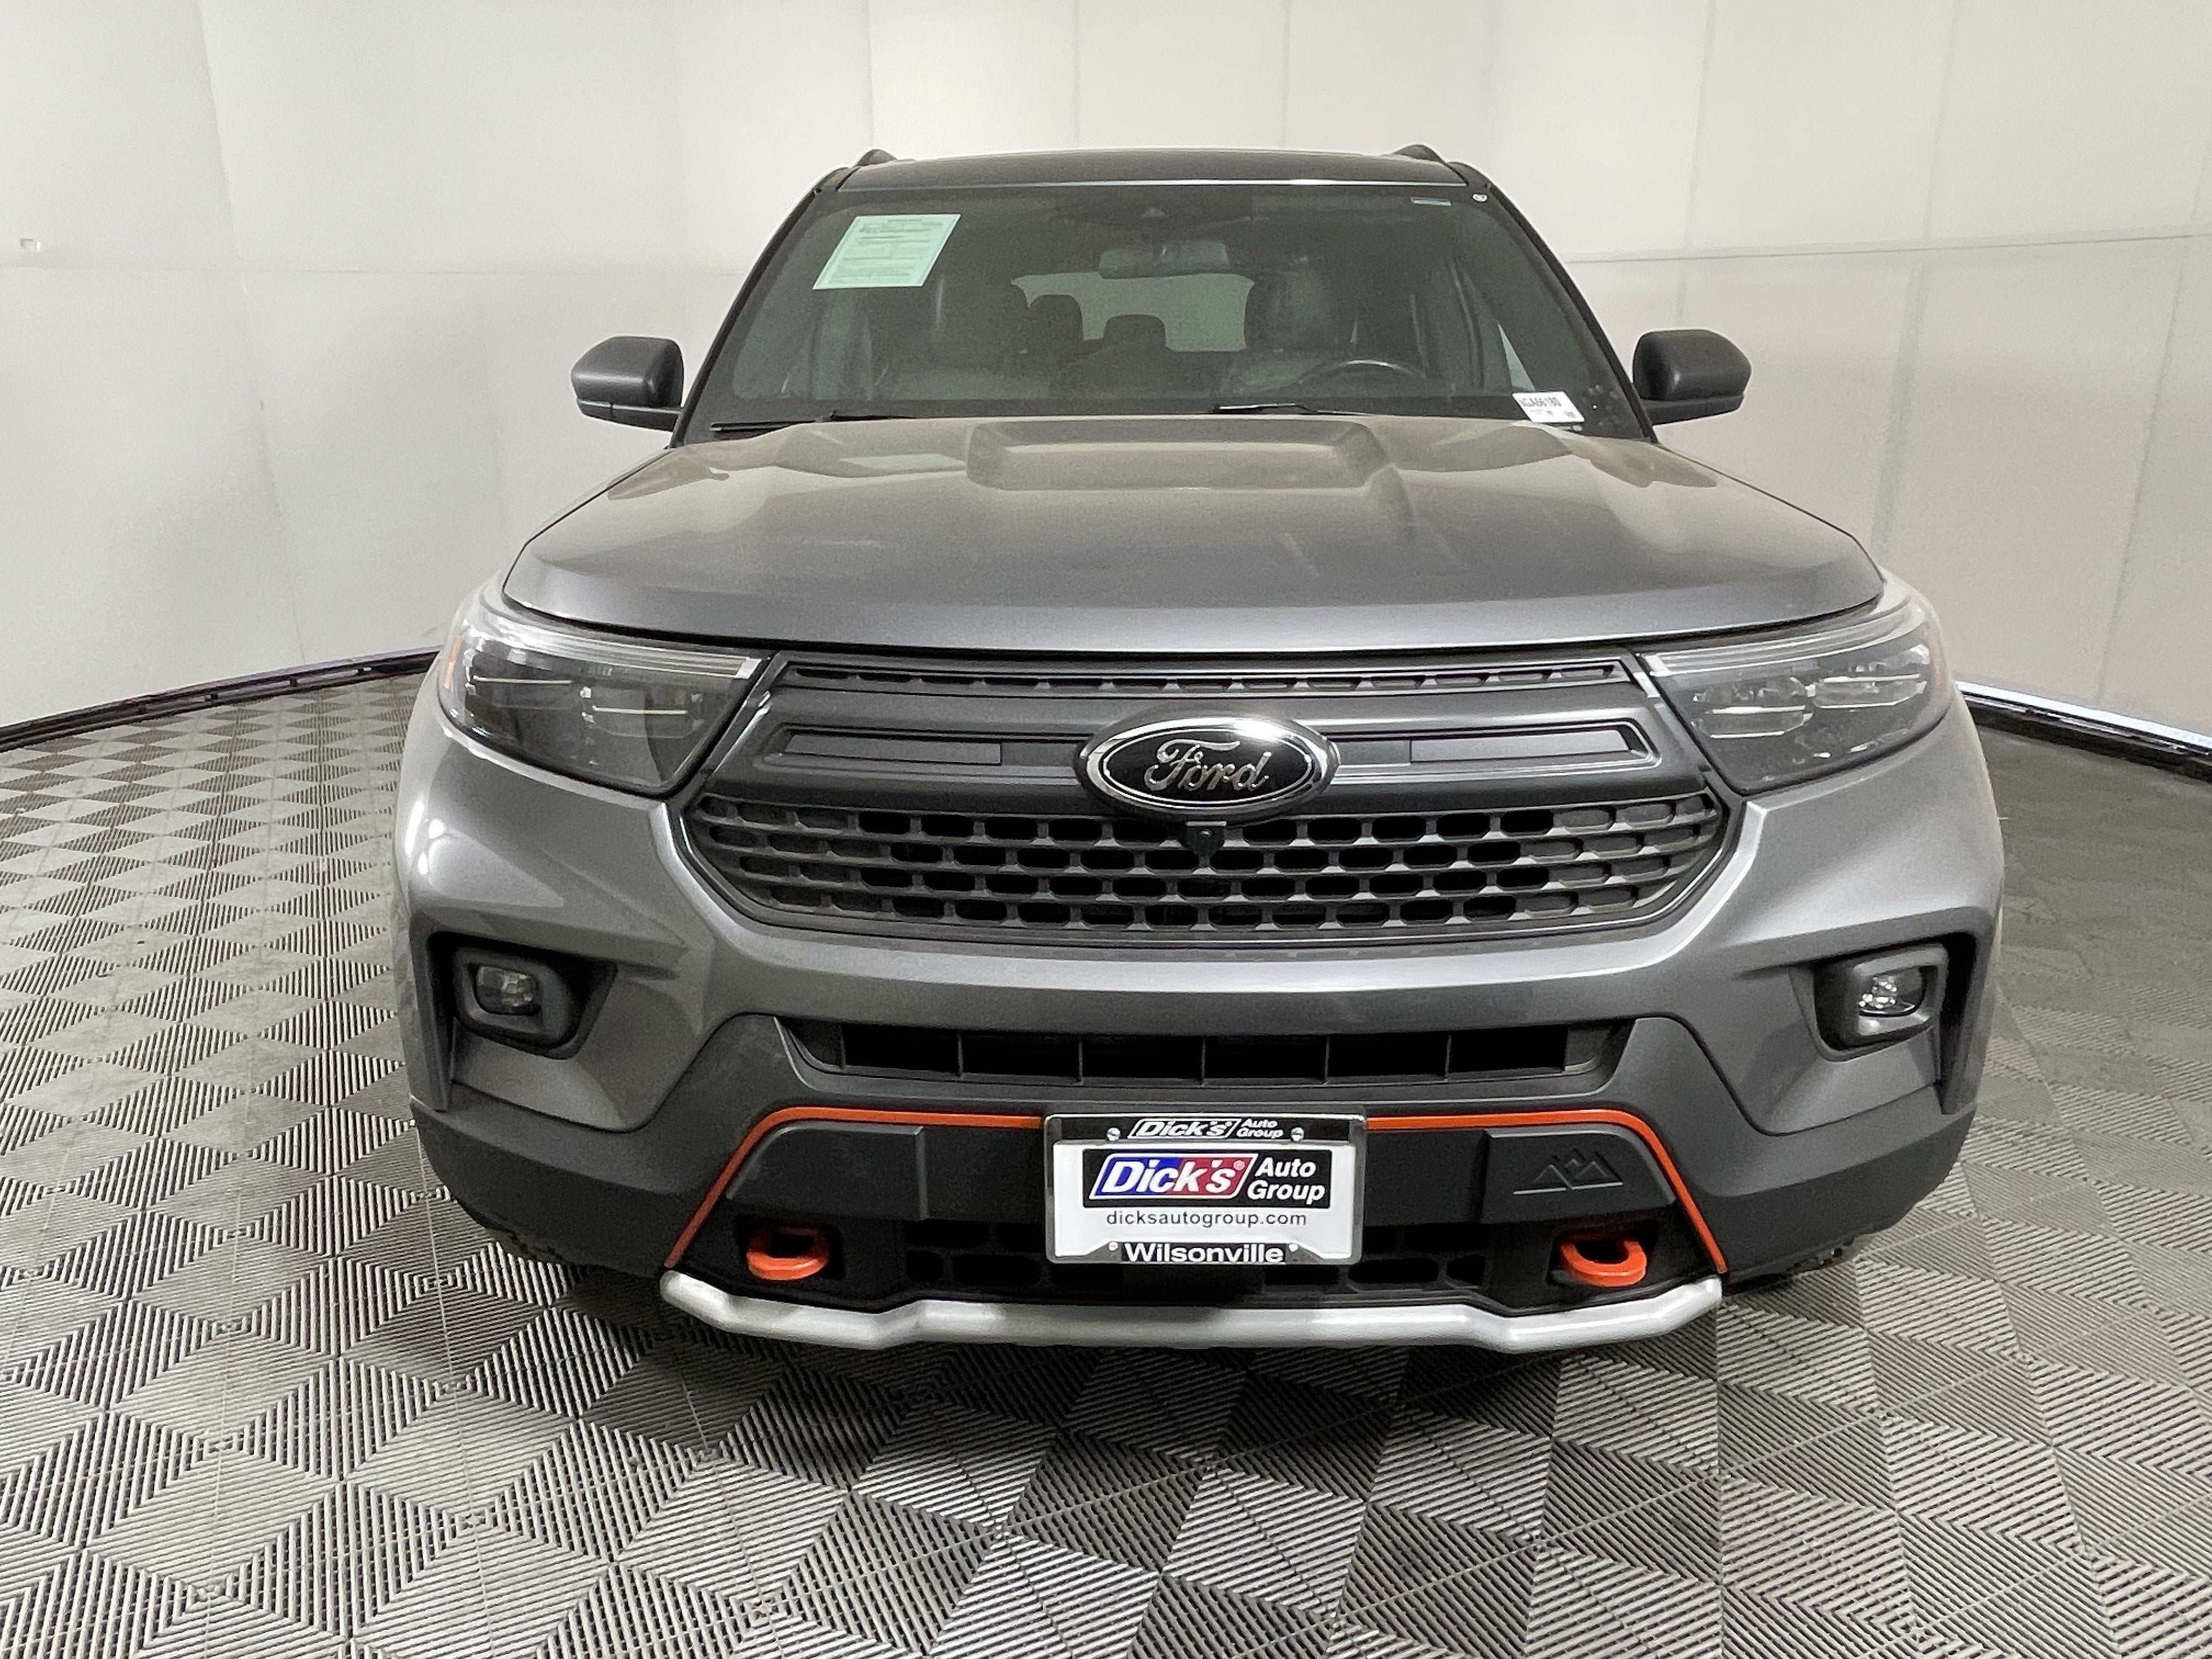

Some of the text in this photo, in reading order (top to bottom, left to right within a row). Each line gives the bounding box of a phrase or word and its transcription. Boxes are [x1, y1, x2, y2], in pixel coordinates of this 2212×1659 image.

[1144, 738, 1272, 791] Ford
[1136, 1120, 1228, 1137] Dick's
[1240, 1118, 1278, 1128] Auto
[1236, 1127, 1284, 1139] Group
[1101, 1159, 1238, 1194] Dick's
[1254, 1157, 1316, 1178] Auto
[1246, 1181, 1325, 1204] Group
[1106, 1210, 1307, 1228] dicksautogroup.com
[1124, 1243, 1284, 1262] Wilsonville
